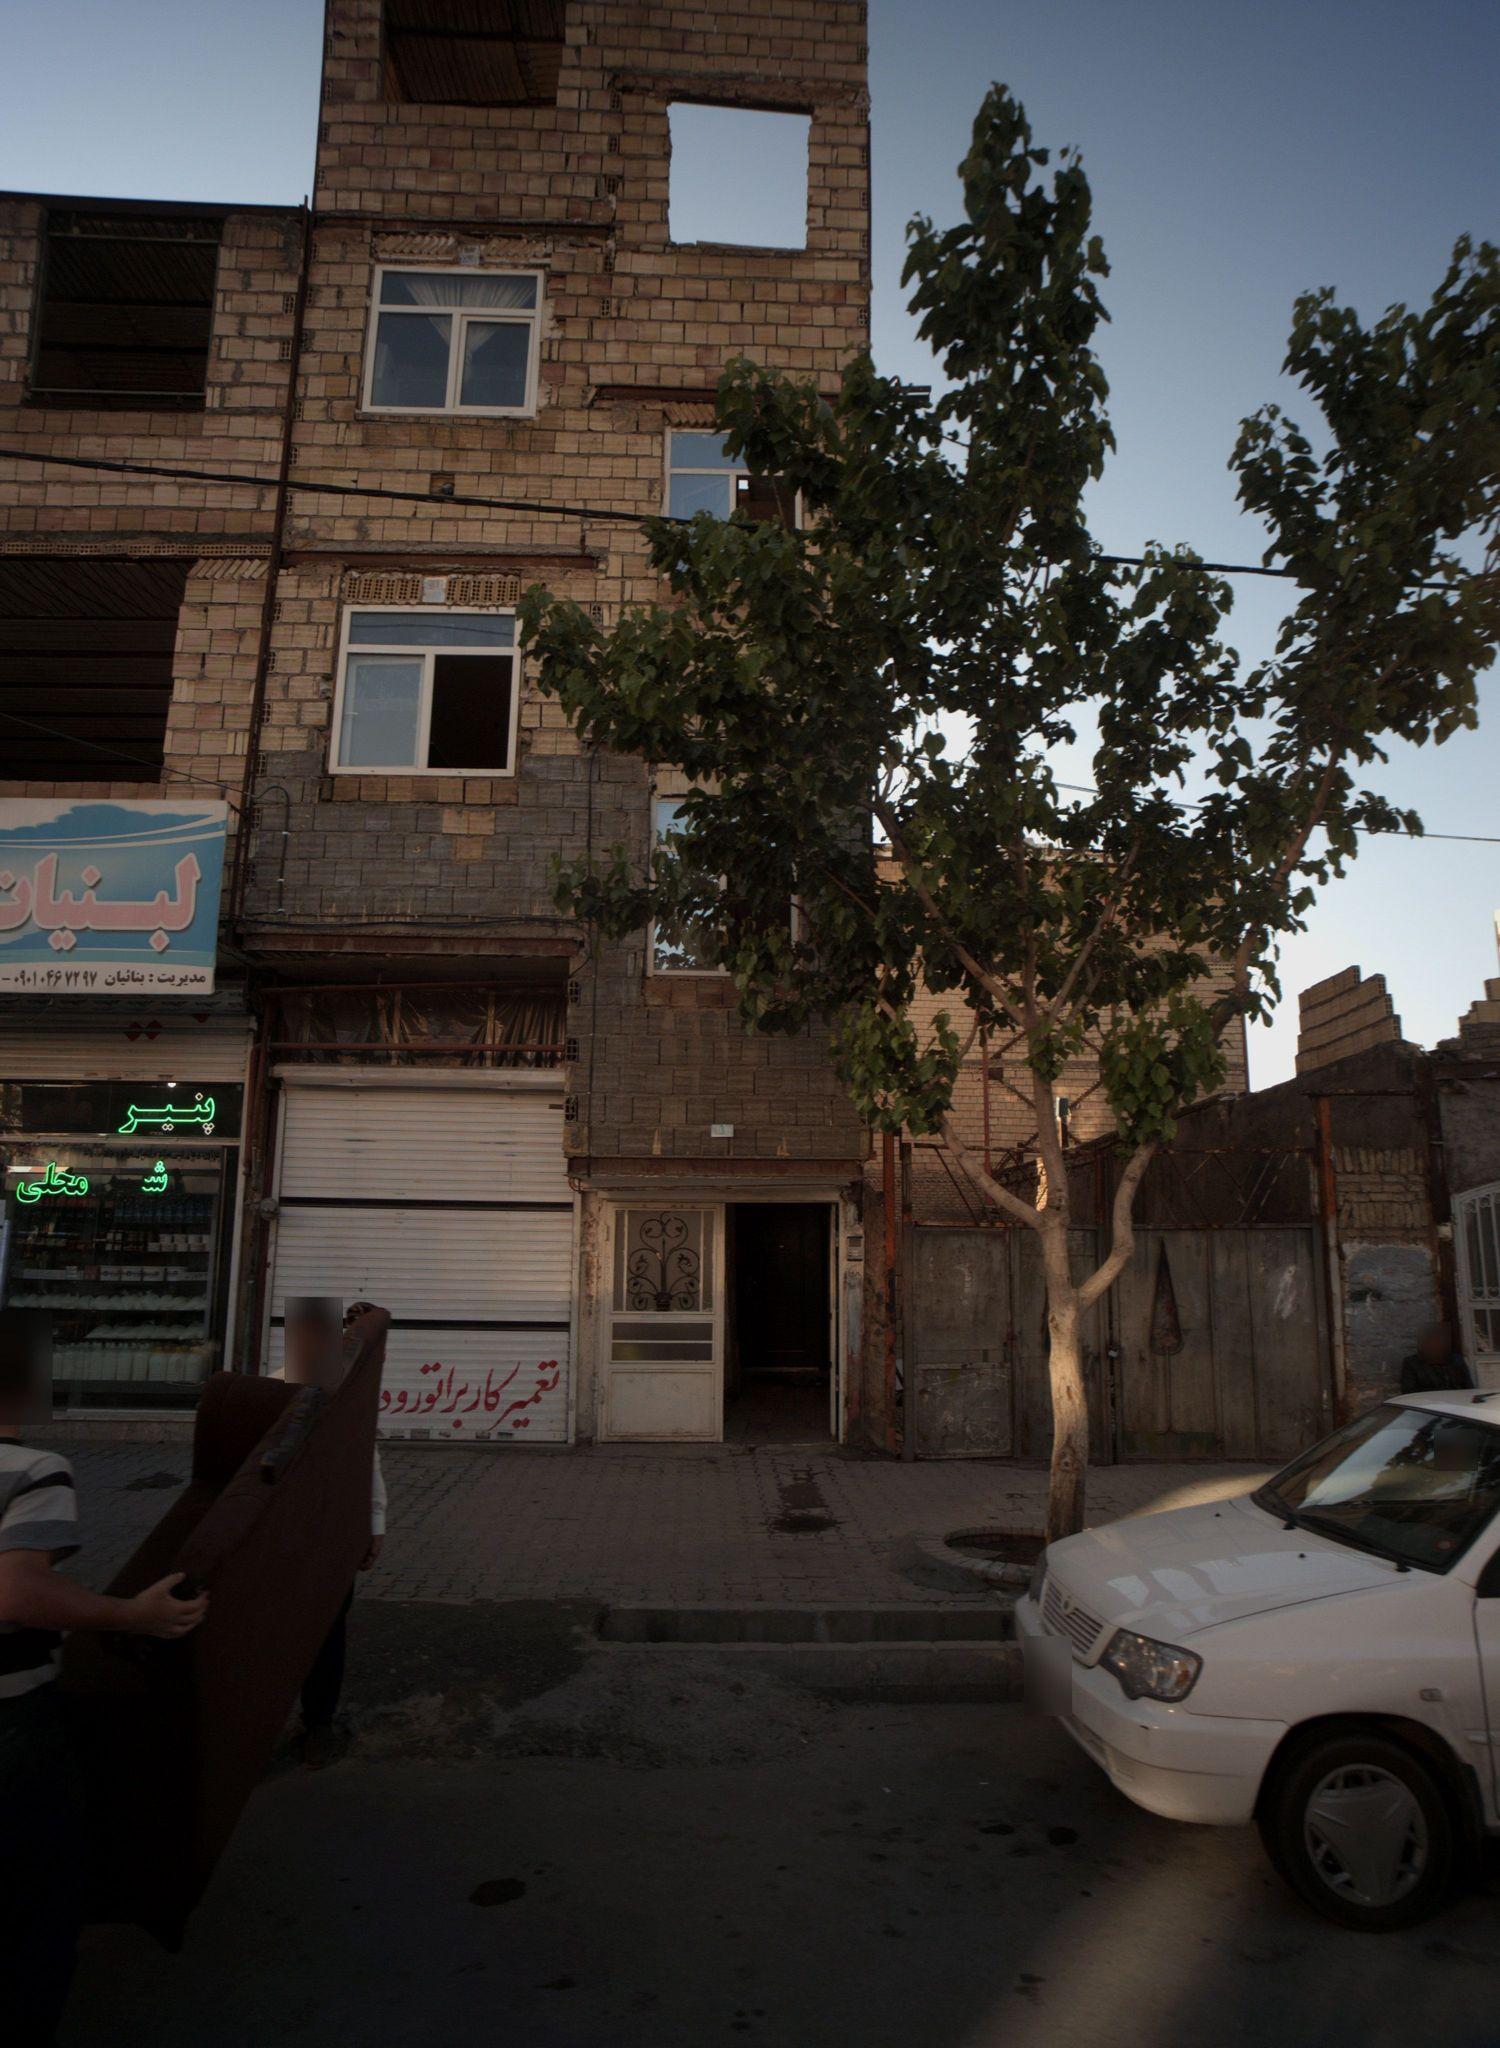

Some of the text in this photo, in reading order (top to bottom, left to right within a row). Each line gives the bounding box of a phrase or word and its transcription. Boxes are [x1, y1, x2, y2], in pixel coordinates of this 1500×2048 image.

[157, 972, 206, 987] مدیریت
[118, 1092, 216, 1136] پنیر
[16, 1161, 89, 1204] محلی
[488, 1359, 561, 1432] تعمیر
